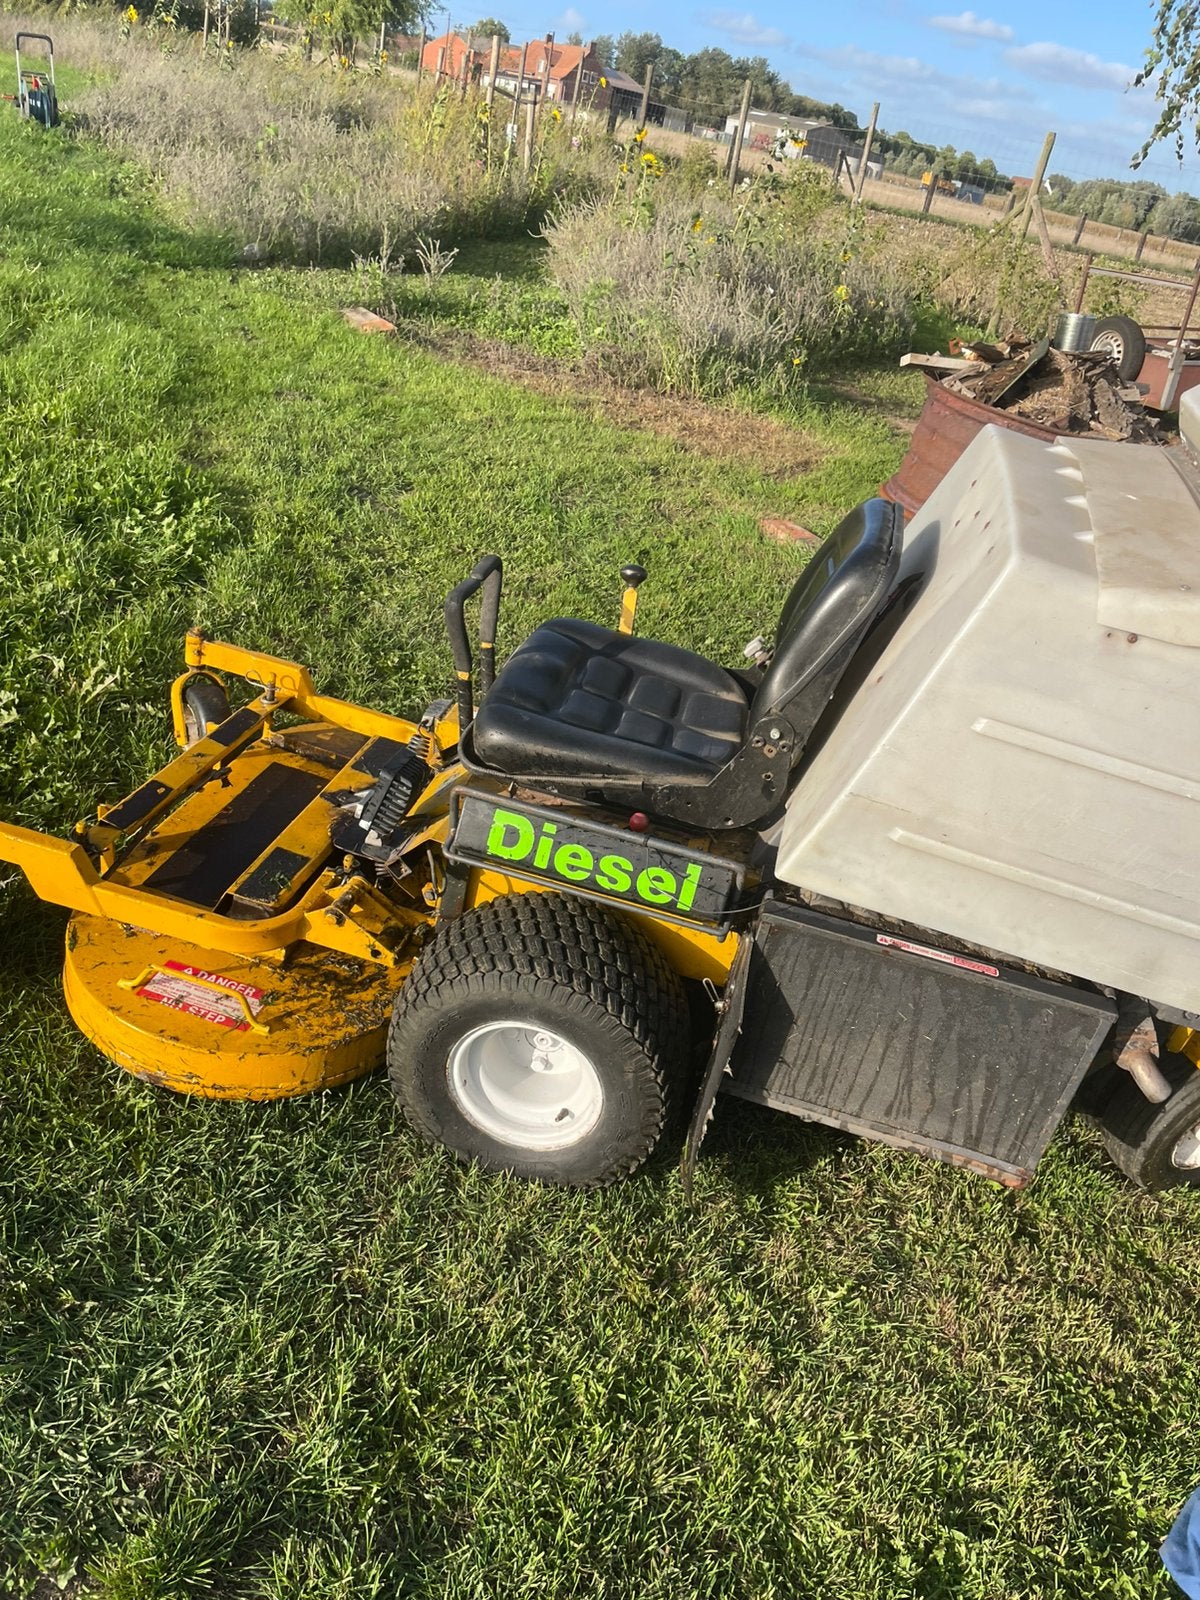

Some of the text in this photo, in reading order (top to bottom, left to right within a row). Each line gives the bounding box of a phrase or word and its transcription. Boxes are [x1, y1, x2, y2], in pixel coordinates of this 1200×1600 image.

[487, 808, 702, 911] Diesel
[196, 970, 256, 997] DANGER
[185, 1004, 226, 1024] STEP
